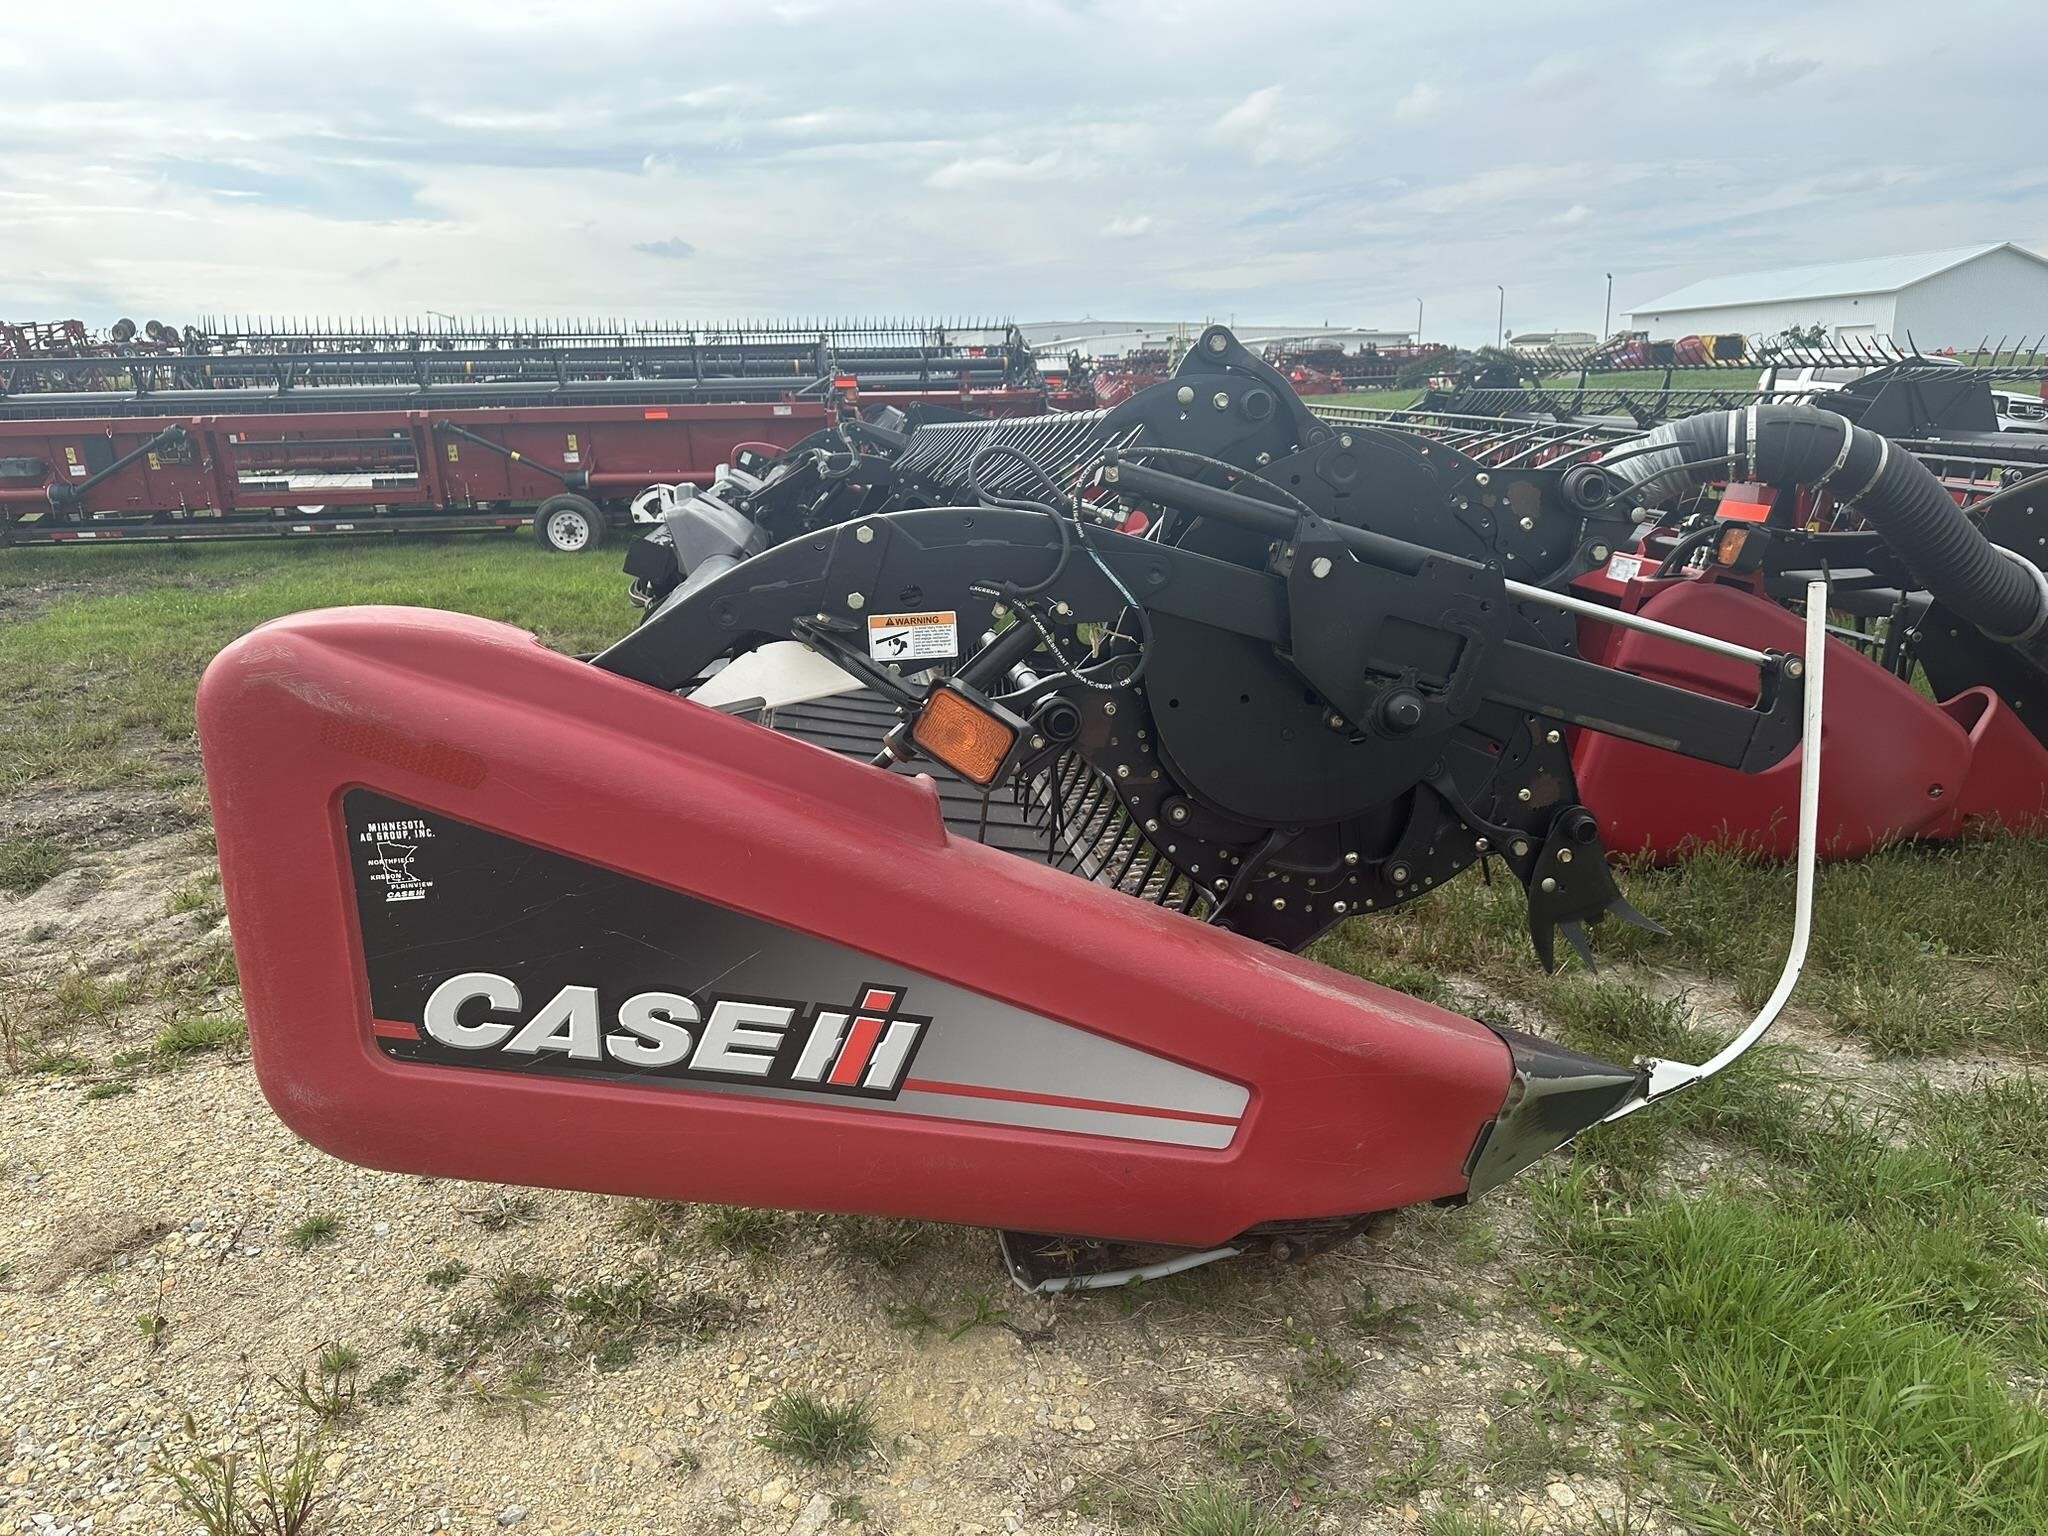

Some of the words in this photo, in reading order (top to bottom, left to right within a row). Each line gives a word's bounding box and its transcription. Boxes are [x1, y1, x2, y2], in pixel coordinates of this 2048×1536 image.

[894, 615, 940, 626] WARNING
[1030, 614, 1047, 635] FLAME
[1045, 635, 1069, 666] RESISTANT
[367, 820, 425, 832] MINNESOTA
[360, 832, 372, 842] AG
[376, 830, 412, 841] GROUP,
[414, 828, 436, 838] INC.
[367, 857, 415, 866] NORTHFIELD
[391, 881, 433, 890] PLAINVIEW
[424, 972, 796, 1077] CASE
